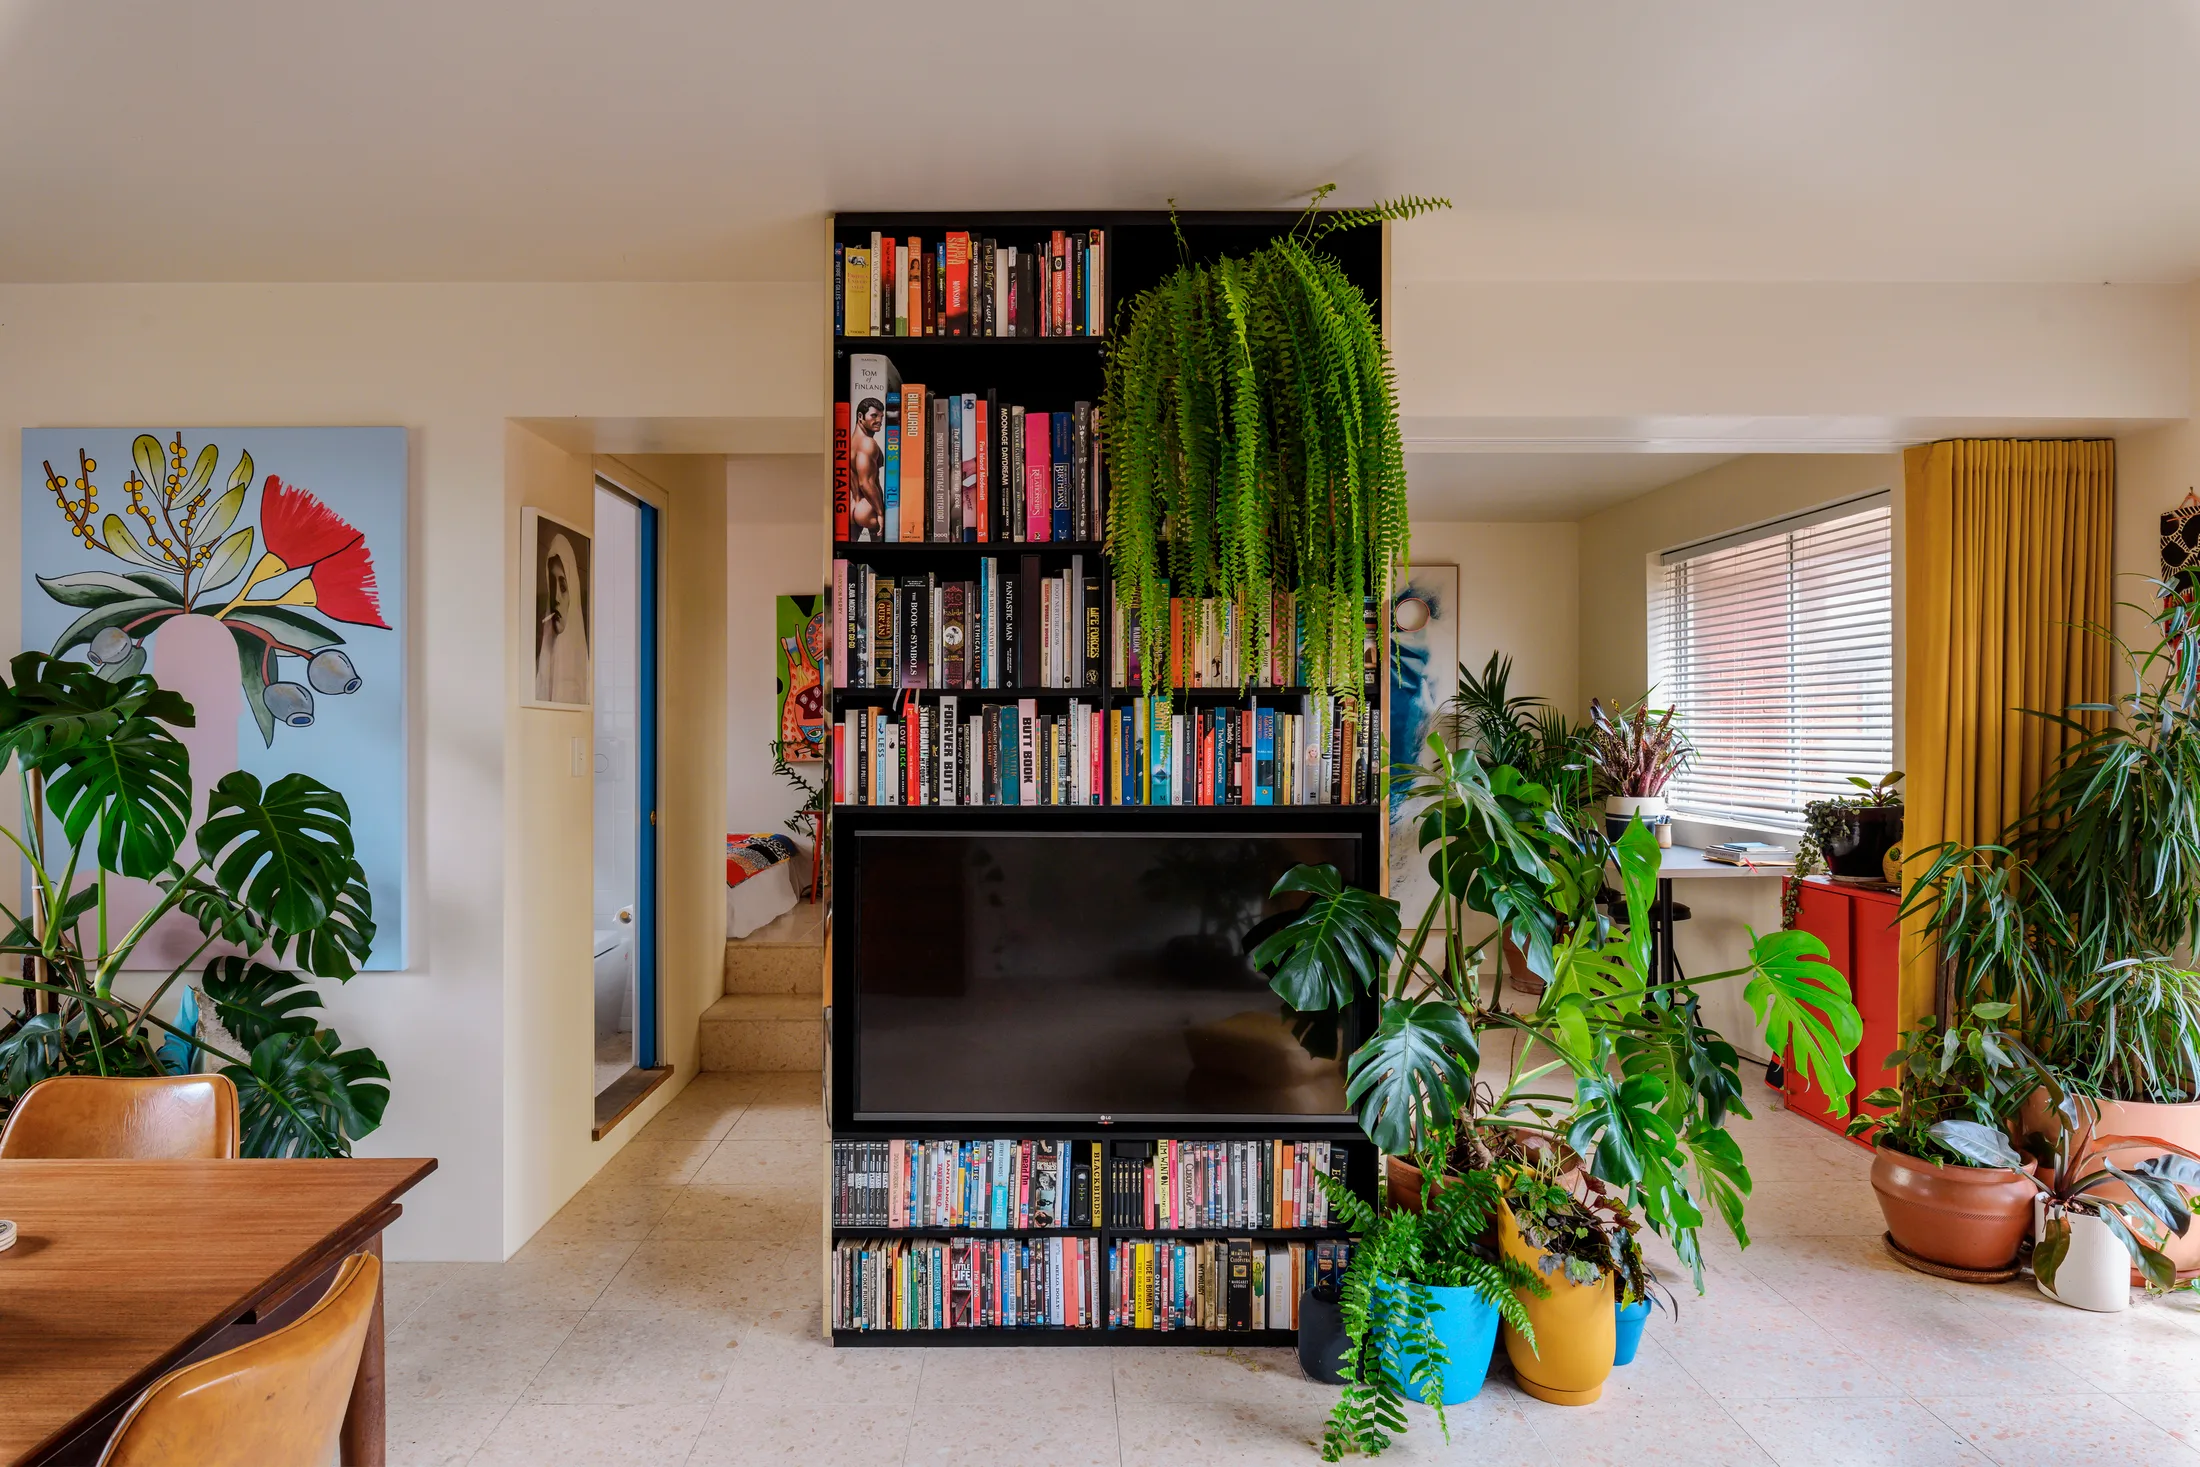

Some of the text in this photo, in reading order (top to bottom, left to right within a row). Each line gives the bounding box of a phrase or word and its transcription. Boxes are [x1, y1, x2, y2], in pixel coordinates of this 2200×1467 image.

[947, 237, 957, 265] SMITH
[958, 237, 966, 265] WILBUR
[952, 280, 960, 308] MONSOON
[985, 271, 995, 290] Things
[854, 383, 884, 391] FINLAND
[907, 393, 918, 437] BILL WARD
[1000, 408, 1008, 446] MOONAGE
[887, 429, 898, 461] BOB'S
[835, 428, 847, 514] REN HANG
[936, 432, 944, 522] INDUSTRIAL VINTAGE INTERIORS
[1054, 465, 1064, 508] BIRTHDAYS
[1032, 469, 1040, 516] RELATIONSHIPS
[910, 602, 918, 627] BOOK
[1090, 607, 1099, 659] LIFE FORCES
[1133, 626, 1141, 653] WARLOCK
[910, 634, 918, 676] SYMBOLS
[920, 707, 930, 727] STAN
[1155, 702, 1165, 730] SMITH
[1362, 706, 1370, 744] DUENDE
[944, 704, 953, 793] FOREVER BUTT
[1226, 723, 1234, 745] Daddy
[1023, 717, 1032, 784] BUTT BOOK
[1160, 1141, 1168, 1186] TIM WINTON
[1010, 1254, 1014, 1262] MY
[952, 1271, 970, 1280] LIFE
